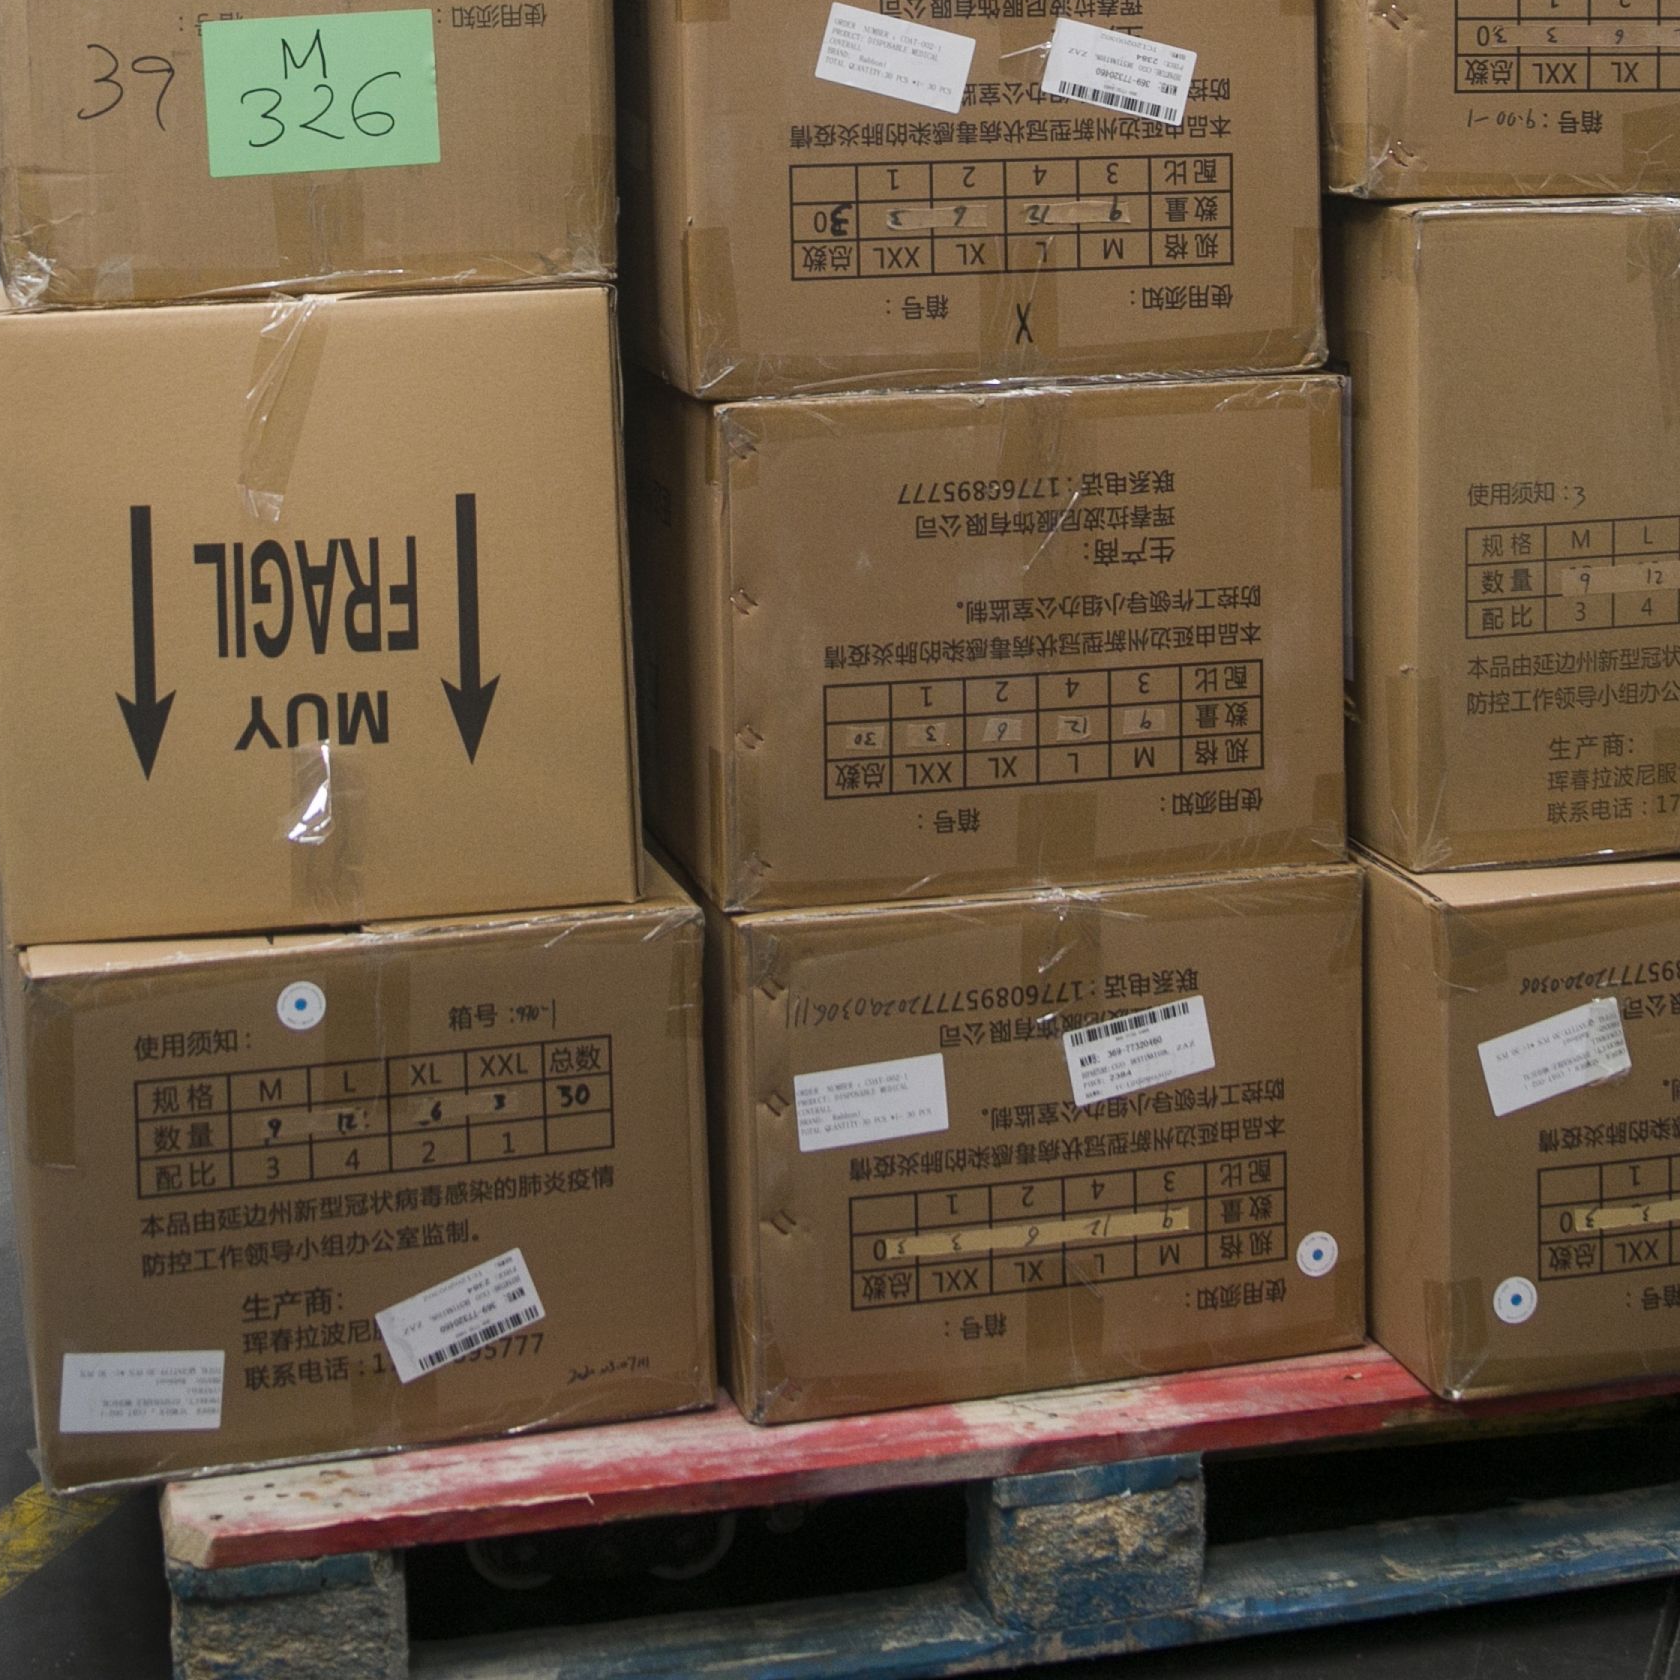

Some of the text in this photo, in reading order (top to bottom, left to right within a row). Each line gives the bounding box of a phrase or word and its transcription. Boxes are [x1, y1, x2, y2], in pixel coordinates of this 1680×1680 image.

[1546, 28, 1556, 42] 3
[1615, 31, 1624, 43] 6
[281, 29, 328, 80] M
[1610, 62, 1638, 83] XL
[1532, 63, 1577, 84] XXL
[240, 71, 401, 148] 326
[193, 535, 420, 658] FRAGIL
[233, 690, 389, 751] MUY
